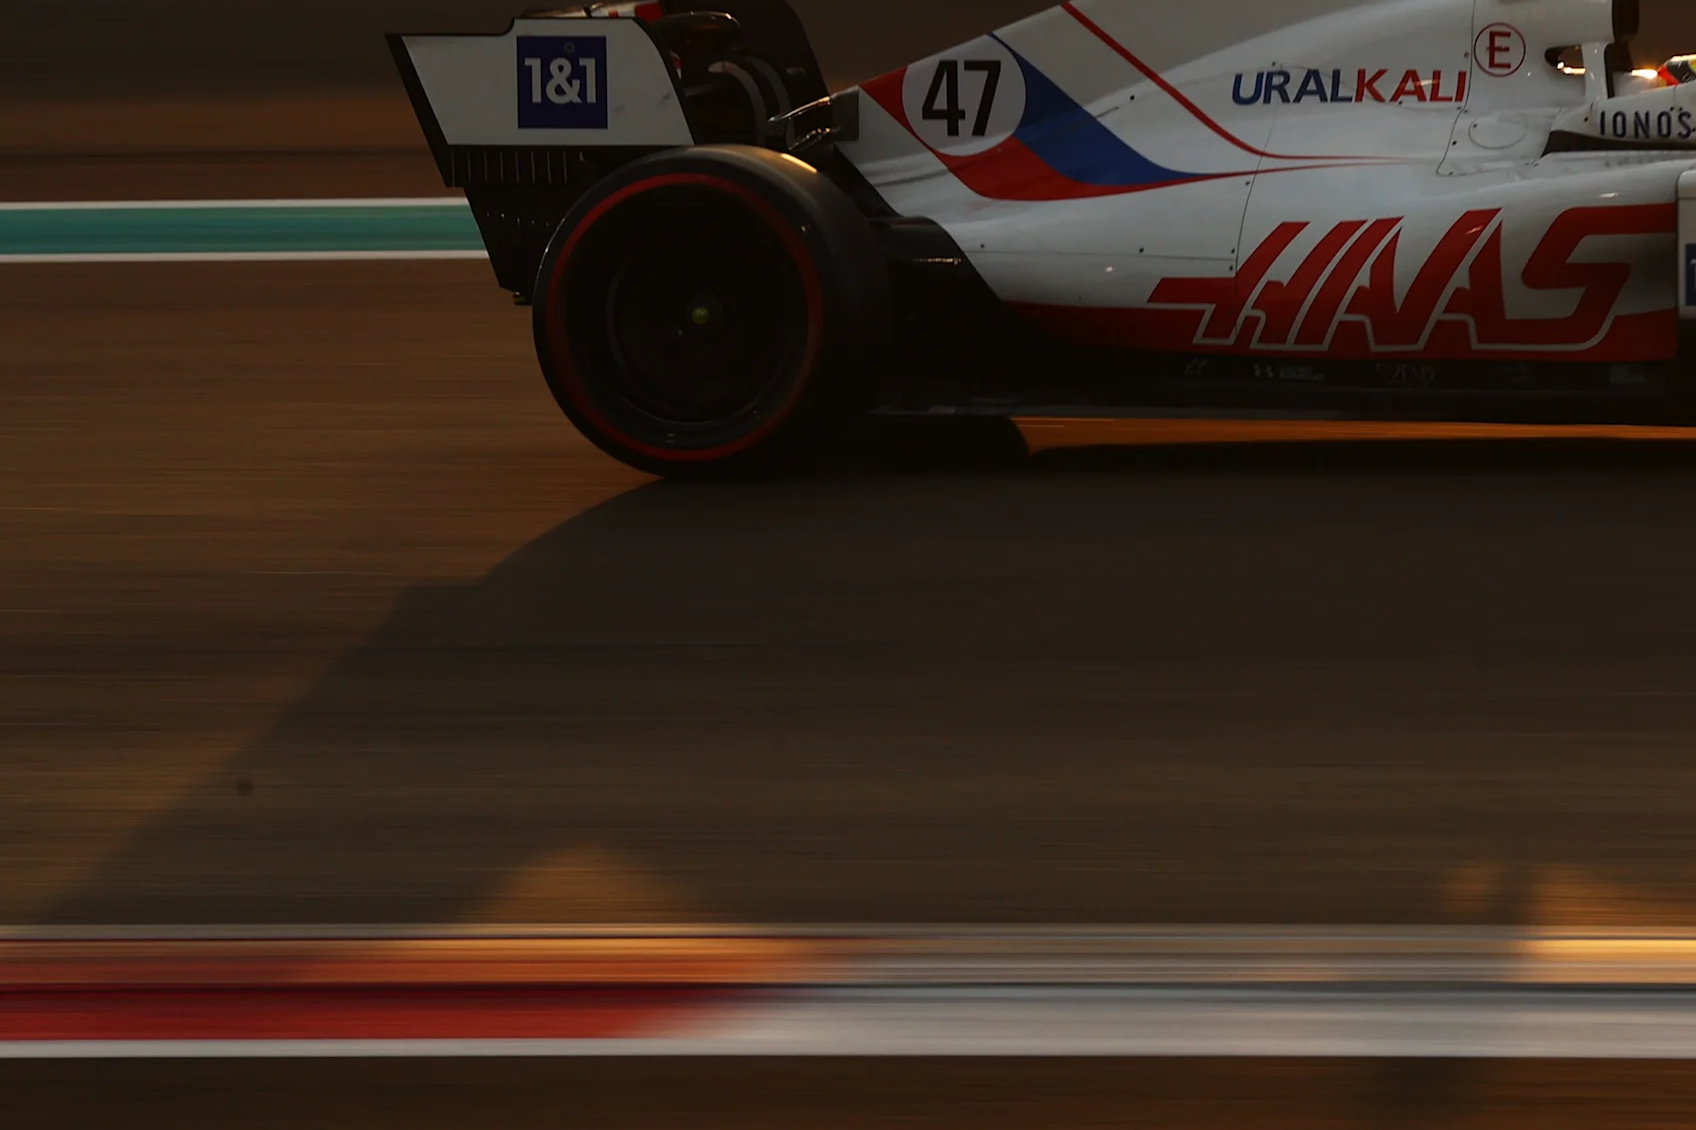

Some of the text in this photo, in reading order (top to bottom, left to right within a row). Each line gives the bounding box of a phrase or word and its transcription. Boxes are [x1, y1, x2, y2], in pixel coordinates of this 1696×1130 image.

[1489, 31, 1511, 69] E
[525, 57, 597, 105] 1&1
[922, 60, 1002, 137] 47
[1232, 68, 1468, 105] URALKALI
[1600, 110, 1693, 139] IONOS
[1147, 207, 1677, 351] HAAS
